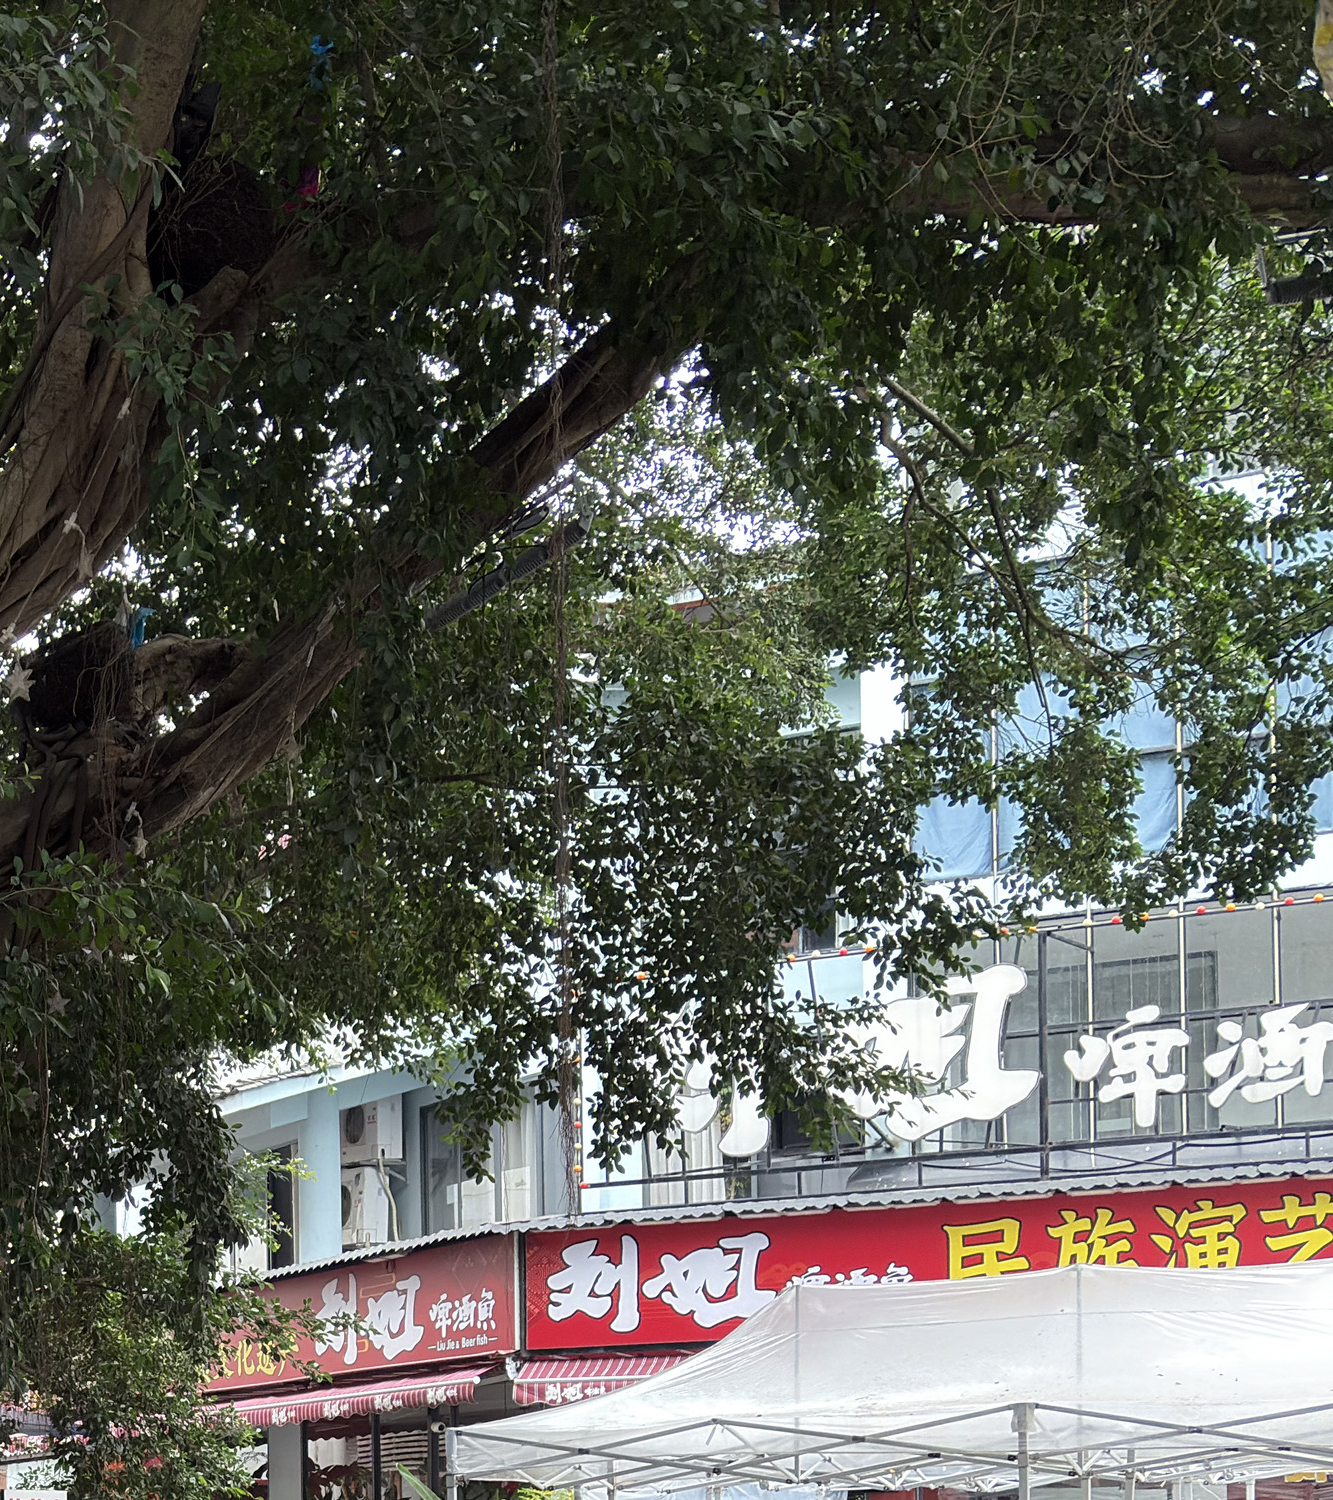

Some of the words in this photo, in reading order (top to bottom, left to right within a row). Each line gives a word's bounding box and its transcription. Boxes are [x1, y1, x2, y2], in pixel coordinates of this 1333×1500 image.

[428, 1287, 497, 1339] 啤酒鱼
[461, 1336, 476, 1349] Beer
